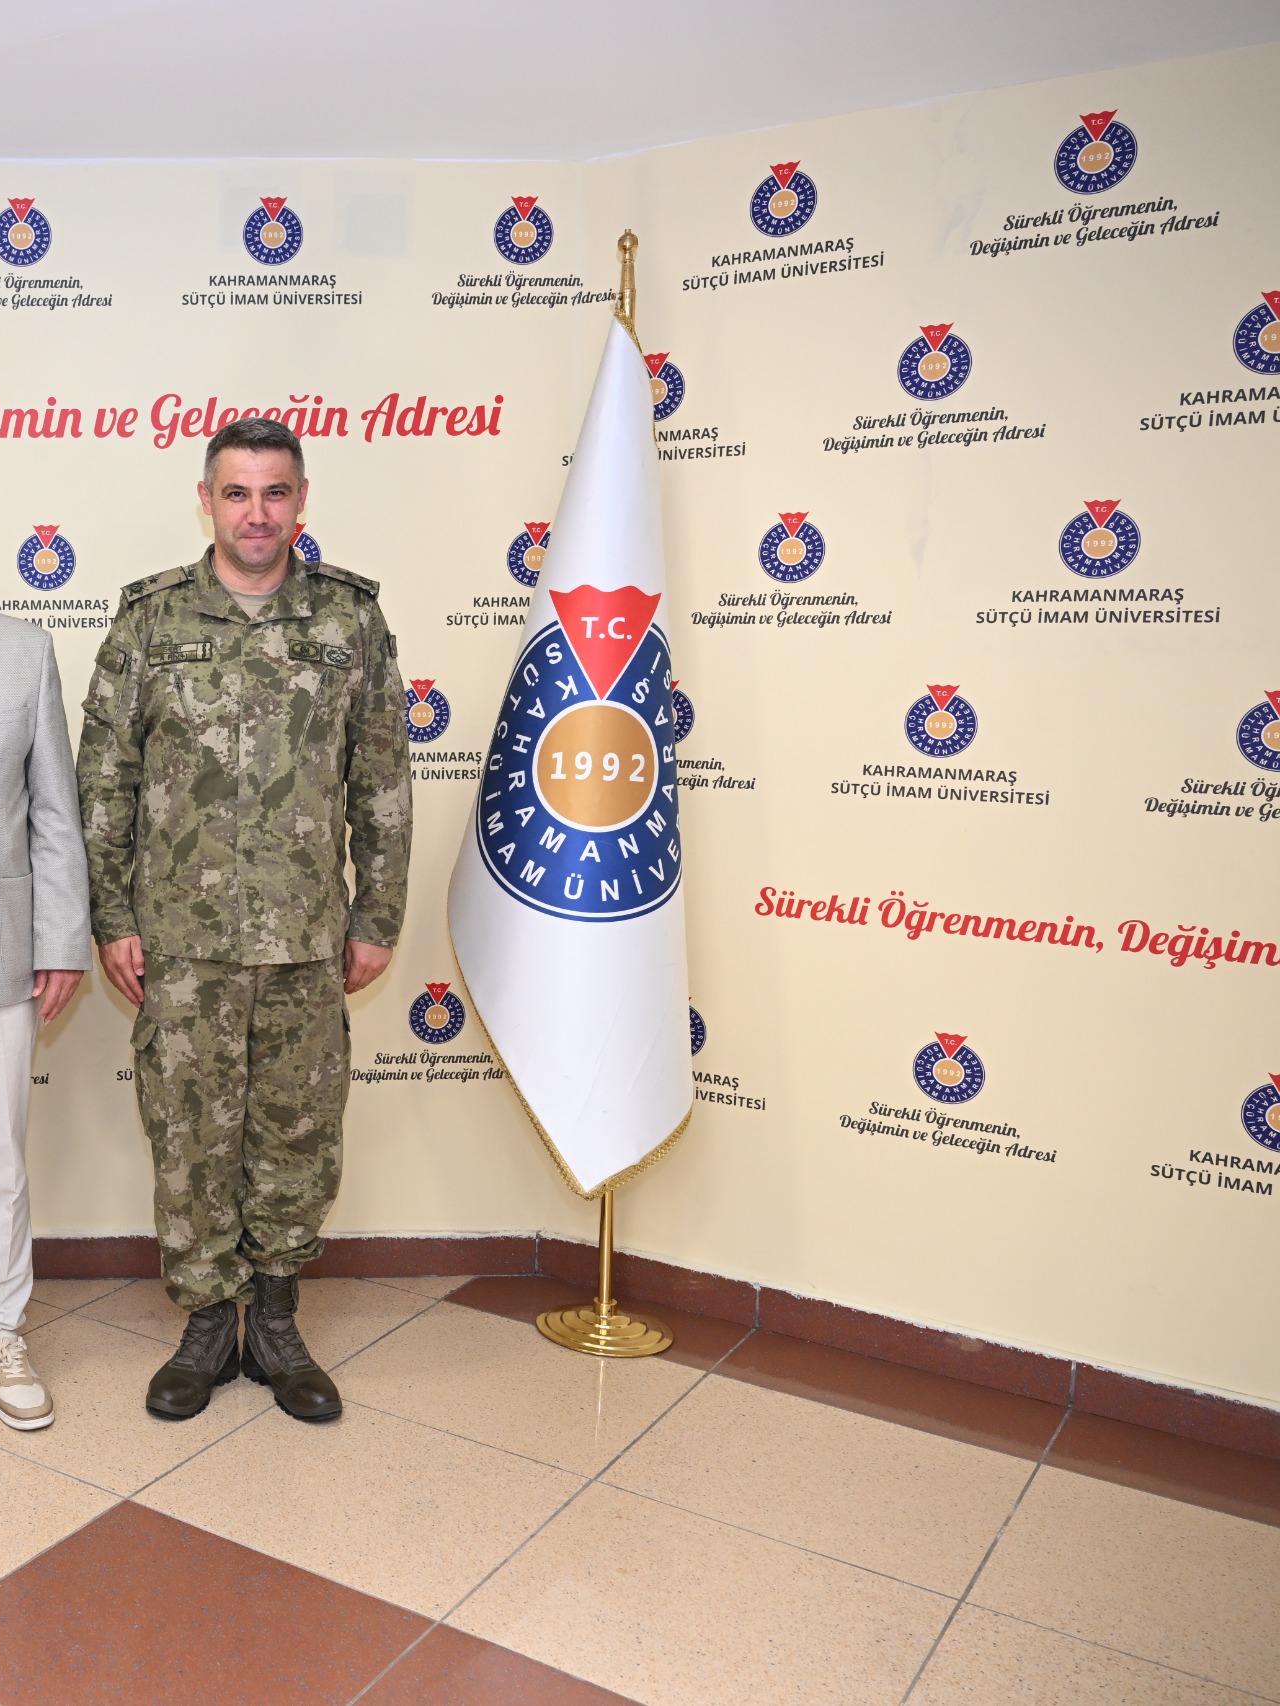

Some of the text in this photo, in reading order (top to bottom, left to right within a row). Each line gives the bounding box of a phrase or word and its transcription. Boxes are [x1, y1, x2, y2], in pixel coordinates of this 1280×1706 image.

[1091, 118, 1106, 126] T.C.
[1081, 152, 1111, 163] 1992
[1003, 196, 1177, 231] Sürekli Öğrenmenin,
[970, 211, 1220, 257] Değişimin ve Geleceğin Adresi
[712, 237, 854, 267] KAHRAMANMARAŞ
[457, 271, 583, 290] Sürekli Öğrenmenin,
[683, 251, 884, 291] SÜTÇÜ İMAM ÜNİVERSİTESİ
[4, 276, 83, 293] Öğrenmenin,
[210, 275, 336, 289] KAHRAMANMARAŞ
[12, 294, 68, 310] Geleceğin
[72, 294, 112, 308] Adresi
[182, 291, 362, 308] SÜTÇÜ İMAM ÜNİVERSİTESİ
[432, 288, 613, 309] Değişimin ve Geleceğin Adresi
[94, 408, 138, 438] ve
[362, 393, 504, 442] Adresi
[853, 407, 1008, 430] Sürekli Öğrenmenin,
[1140, 411, 1202, 432] SÜTÇÜ
[1209, 410, 1265, 426] İMAM
[823, 424, 1046, 454] Değişimin ve Geleceğin Adresi
[718, 589, 858, 610] Sürekli Öğrenmenin,
[1012, 588, 1184, 605] KAHRAMANMARAŞ
[447, 615, 488, 628] SÜTÇÜ
[691, 610, 892, 628] Değişimin ve Geleceğin Adresi
[976, 607, 1220, 627] SÜTÇÜ İMAM ÜNİVERSİTESİ
[581, 616, 632, 640] T.C.
[489, 643, 562, 771] SÜTÇÜ
[509, 676, 674, 862] KAHRAMANMARAŞ
[550, 751, 645, 783] 1992
[863, 764, 1017, 786] KAHRAMANMARAŞ
[712, 775, 756, 789] Adresi
[831, 780, 1049, 805] SÜTÇÜ İMAM ÜNİVERSİTESİ
[1181, 778, 1246, 796] Sürekli
[1144, 797, 1230, 818] Değişimin
[1235, 806, 1254, 817] ve
[486, 791, 546, 886] İMAM
[755, 887, 1280, 969] Sürekli Öğrenmenin, Değişim
[944, 1038, 957, 1046] T.C.
[374, 1050, 494, 1067] Sürekli Öğrenmenin,
[350, 1068, 479, 1084] Değişimin ve Geleceğin
[936, 1068, 961, 1077] 1992
[696, 1087, 766, 1110] İVERSİTESİ
[869, 1101, 1020, 1139] Sürekli Öğrenmenin,
[840, 1115, 1057, 1163] Değişimin ve Geleceğin Adresi
[1151, 1164, 1272, 1195] SÜTÇÜ İMAM
